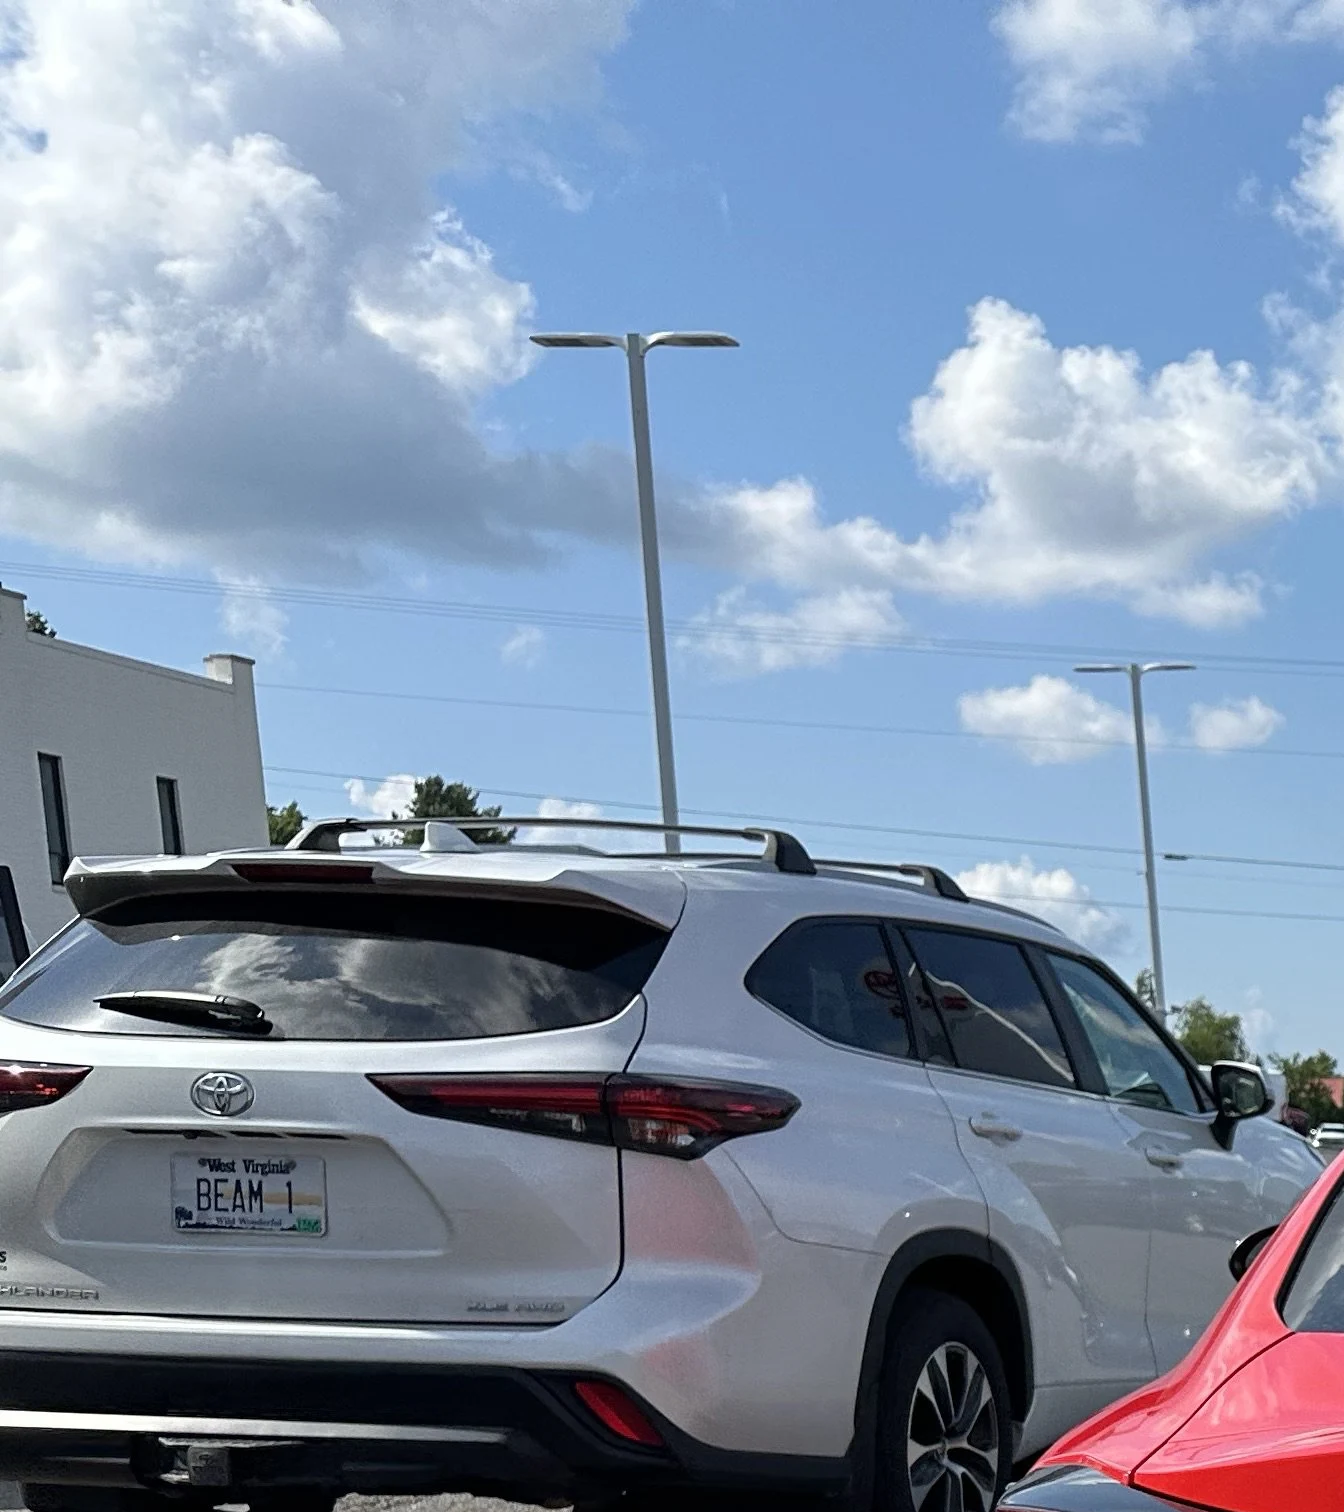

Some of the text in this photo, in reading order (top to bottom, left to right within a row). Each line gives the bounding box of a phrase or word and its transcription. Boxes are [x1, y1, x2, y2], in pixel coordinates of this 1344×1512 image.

[207, 1158, 290, 1176] West Virginia
[197, 1178, 293, 1213] BEAM 1
